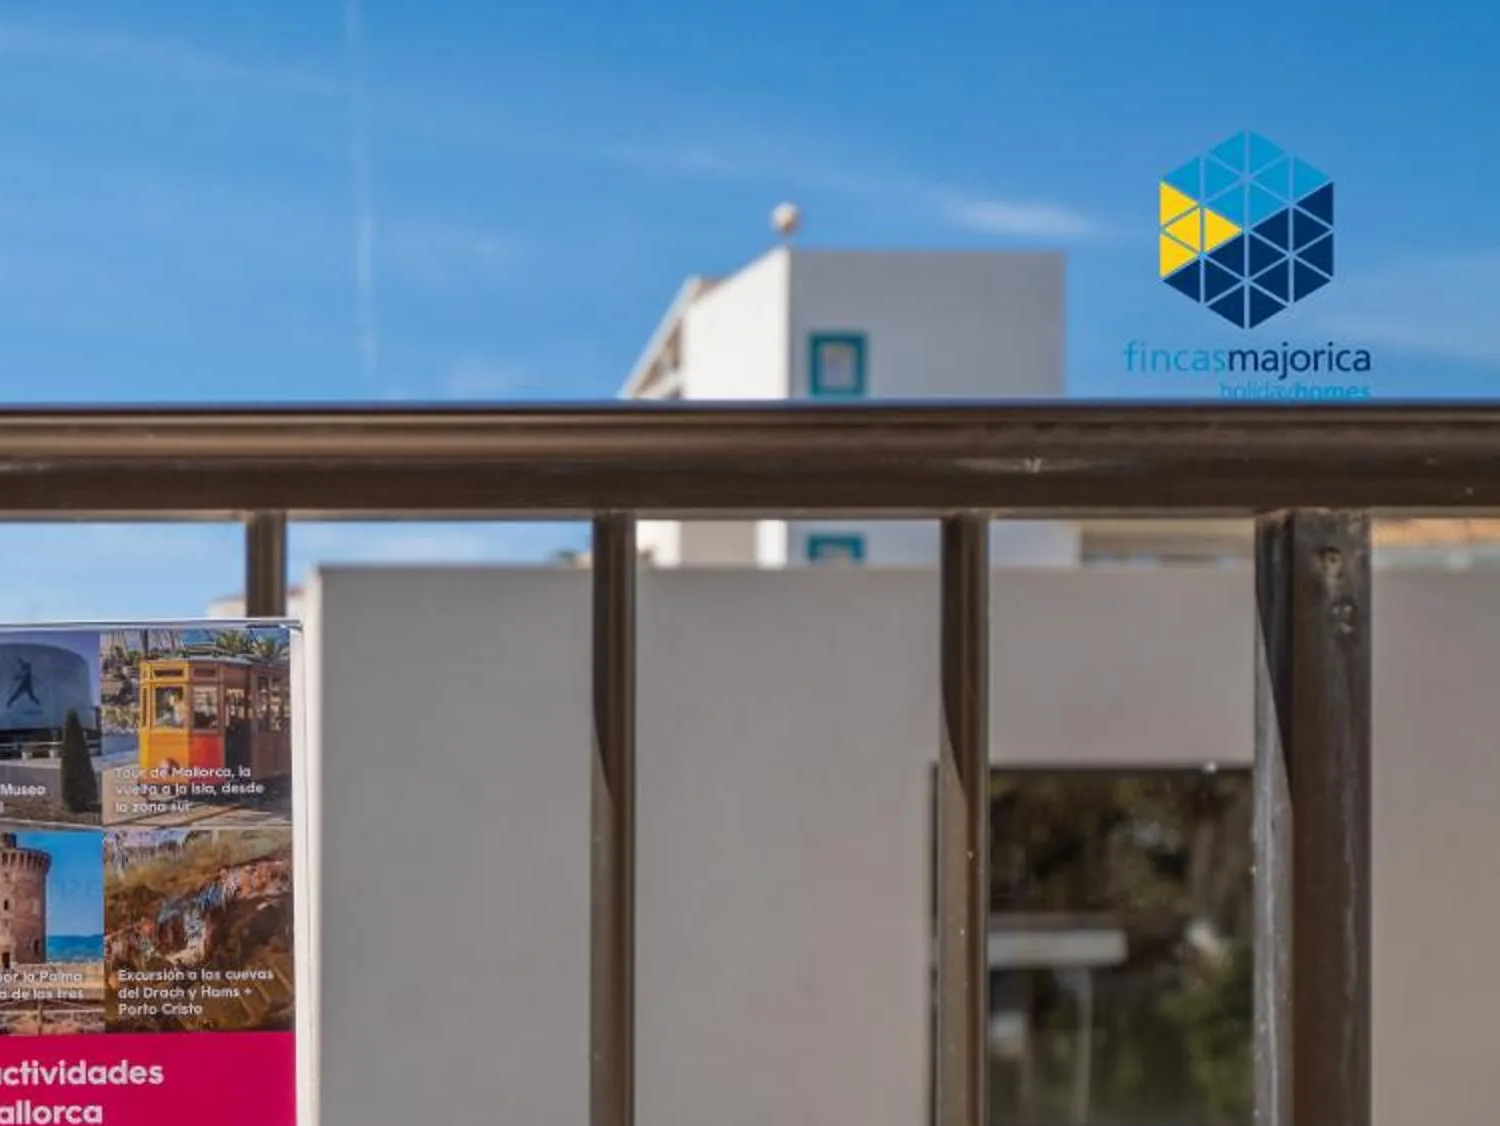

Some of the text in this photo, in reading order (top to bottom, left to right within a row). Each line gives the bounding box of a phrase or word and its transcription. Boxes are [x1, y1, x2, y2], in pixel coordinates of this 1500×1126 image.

[114, 765, 251, 779] Tour de Mallorca, la
[0, 783, 46, 796] Museo
[222, 782, 265, 794] desde
[115, 802, 128, 813] la
[133, 802, 167, 813] zona
[40, 971, 84, 982] Palma
[225, 969, 274, 981] cuevas
[11, 989, 29, 1000] de
[33, 988, 53, 1000] las
[56, 988, 84, 1000] tres
[117, 987, 140, 1000] del
[143, 987, 185, 1000] Drach
[188, 988, 198, 1001] y
[118, 1003, 203, 1016] Porto Cristo
